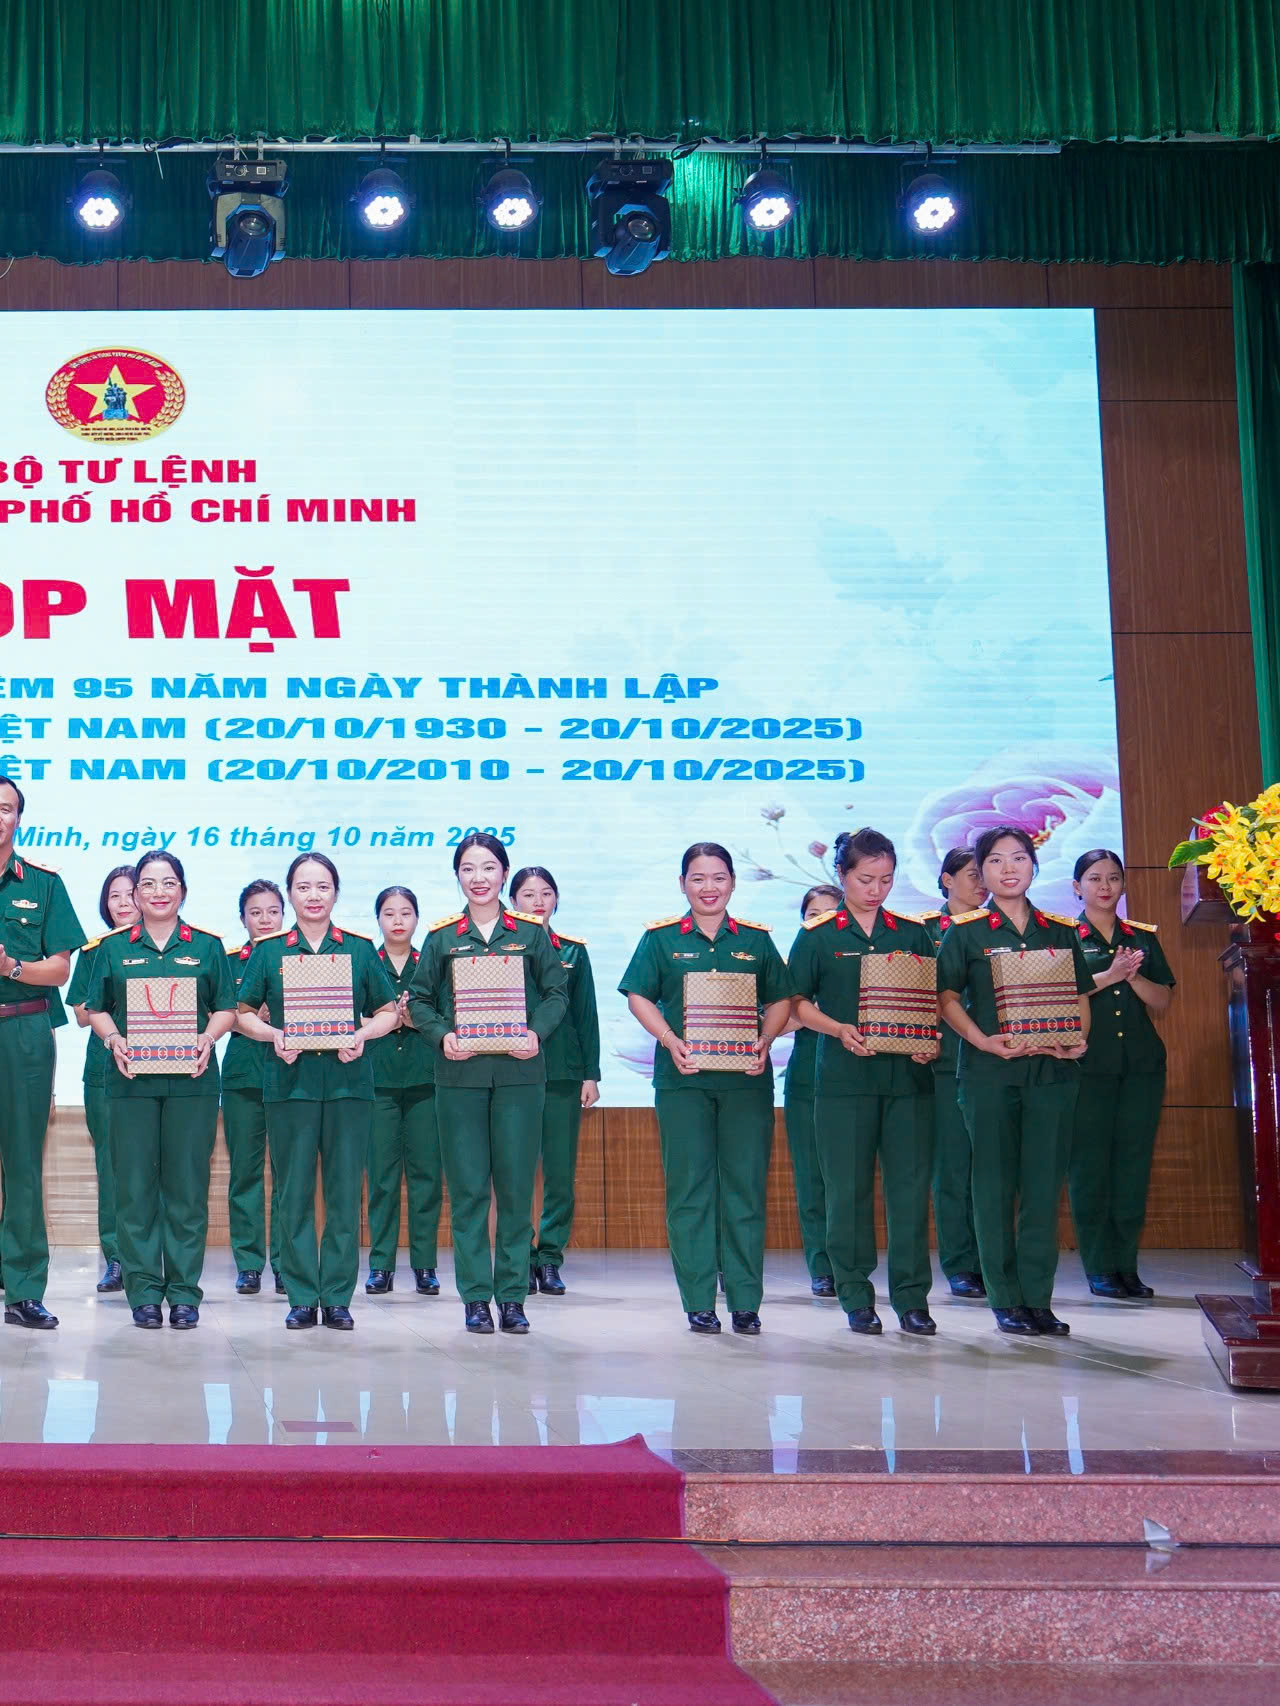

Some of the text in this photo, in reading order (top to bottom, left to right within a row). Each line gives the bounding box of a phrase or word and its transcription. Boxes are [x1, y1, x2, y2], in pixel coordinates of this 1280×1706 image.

[58, 457, 124, 484] TƯ
[133, 454, 257, 488] LỆNH
[110, 491, 172, 523] HỒ
[191, 493, 270, 523] CHÍ
[286, 498, 416, 523] MINH
[124, 565, 351, 653] MẶT
[72, 677, 134, 699] 95
[151, 672, 268, 700] NĂM
[286, 671, 423, 700] NGÀY
[438, 672, 609, 700] THÀNH
[623, 672, 720, 705] LẬP
[68, 717, 187, 740] NAM
[205, 716, 508, 742] (20/10/1930
[559, 716, 865, 743] 20/10/2025)
[69, 758, 187, 781] NAM
[207, 757, 511, 783] (20/10/2010
[560, 757, 869, 784] 20/10/2025)
[12, 825, 90, 851] Minh,
[101, 826, 177, 854] ngày
[186, 825, 221, 848] 16
[229, 825, 317, 854] tháng
[327, 825, 362, 848] 10
[369, 825, 436, 848] năm
